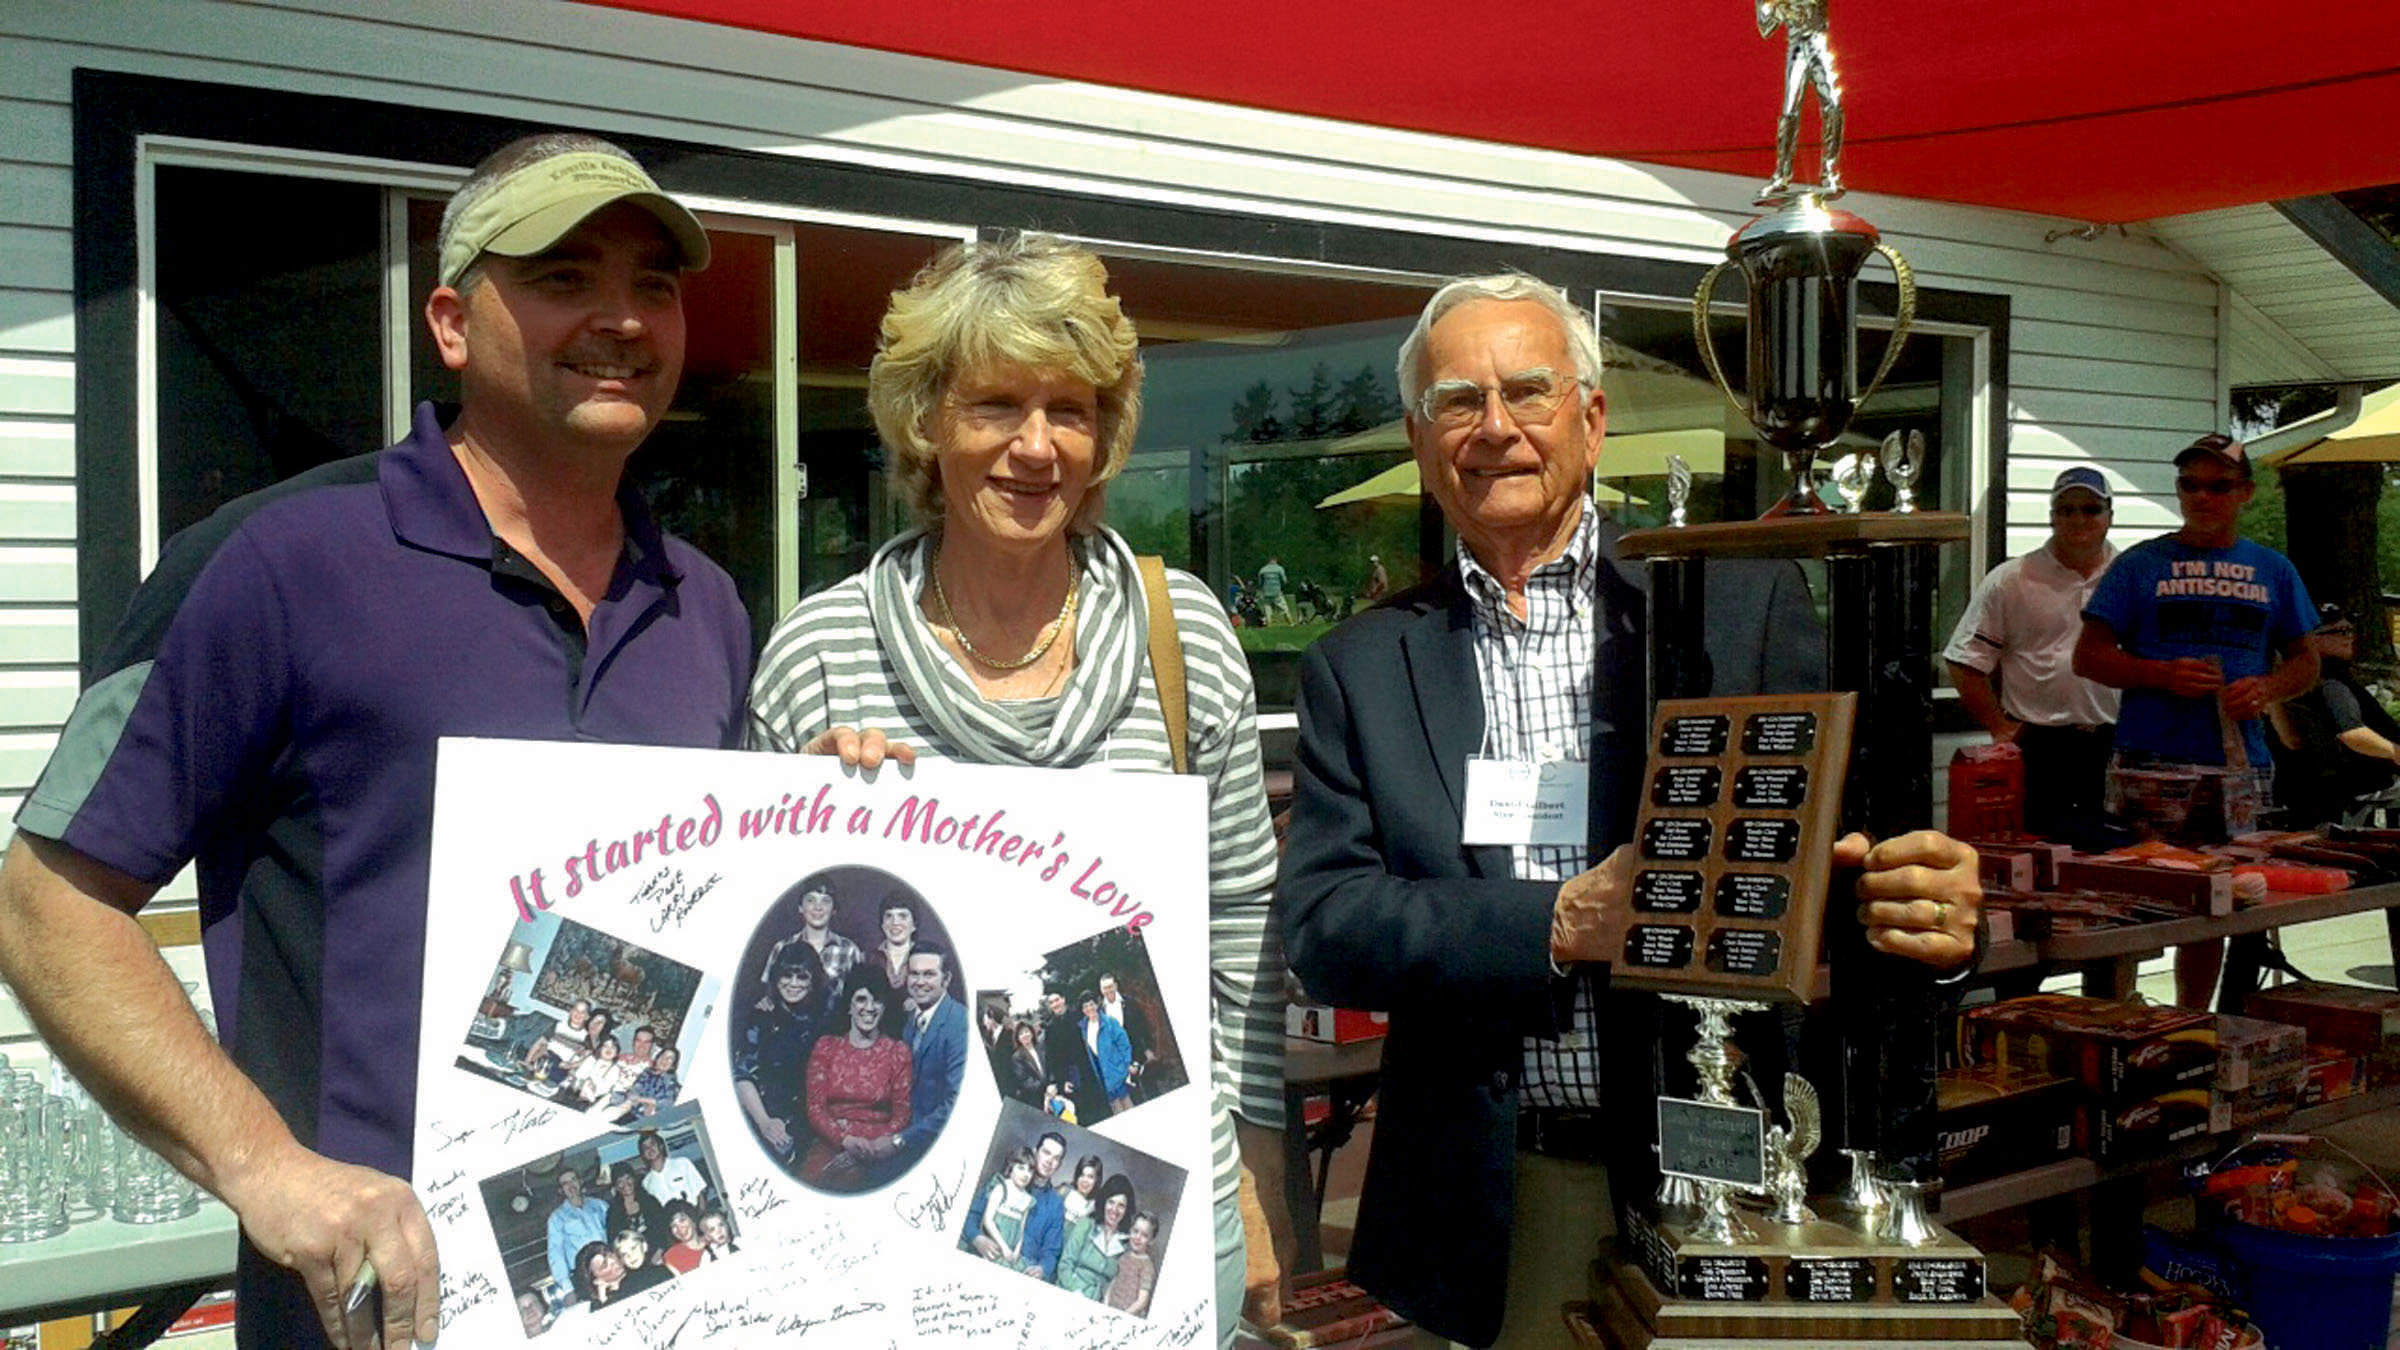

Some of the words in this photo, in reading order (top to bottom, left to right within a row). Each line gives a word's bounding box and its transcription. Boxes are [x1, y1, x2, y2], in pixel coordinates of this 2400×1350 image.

[2171, 560, 2207, 578] I'M
[2212, 561, 2256, 581] NOT
[2156, 577, 2270, 603] ANTISOCIAL
[509, 867, 554, 923] It
[564, 793, 722, 899] started
[738, 783, 836, 840] with
[846, 806, 873, 835] a
[882, 796, 1070, 884] Mother's
[1070, 857, 1155, 936] Love
